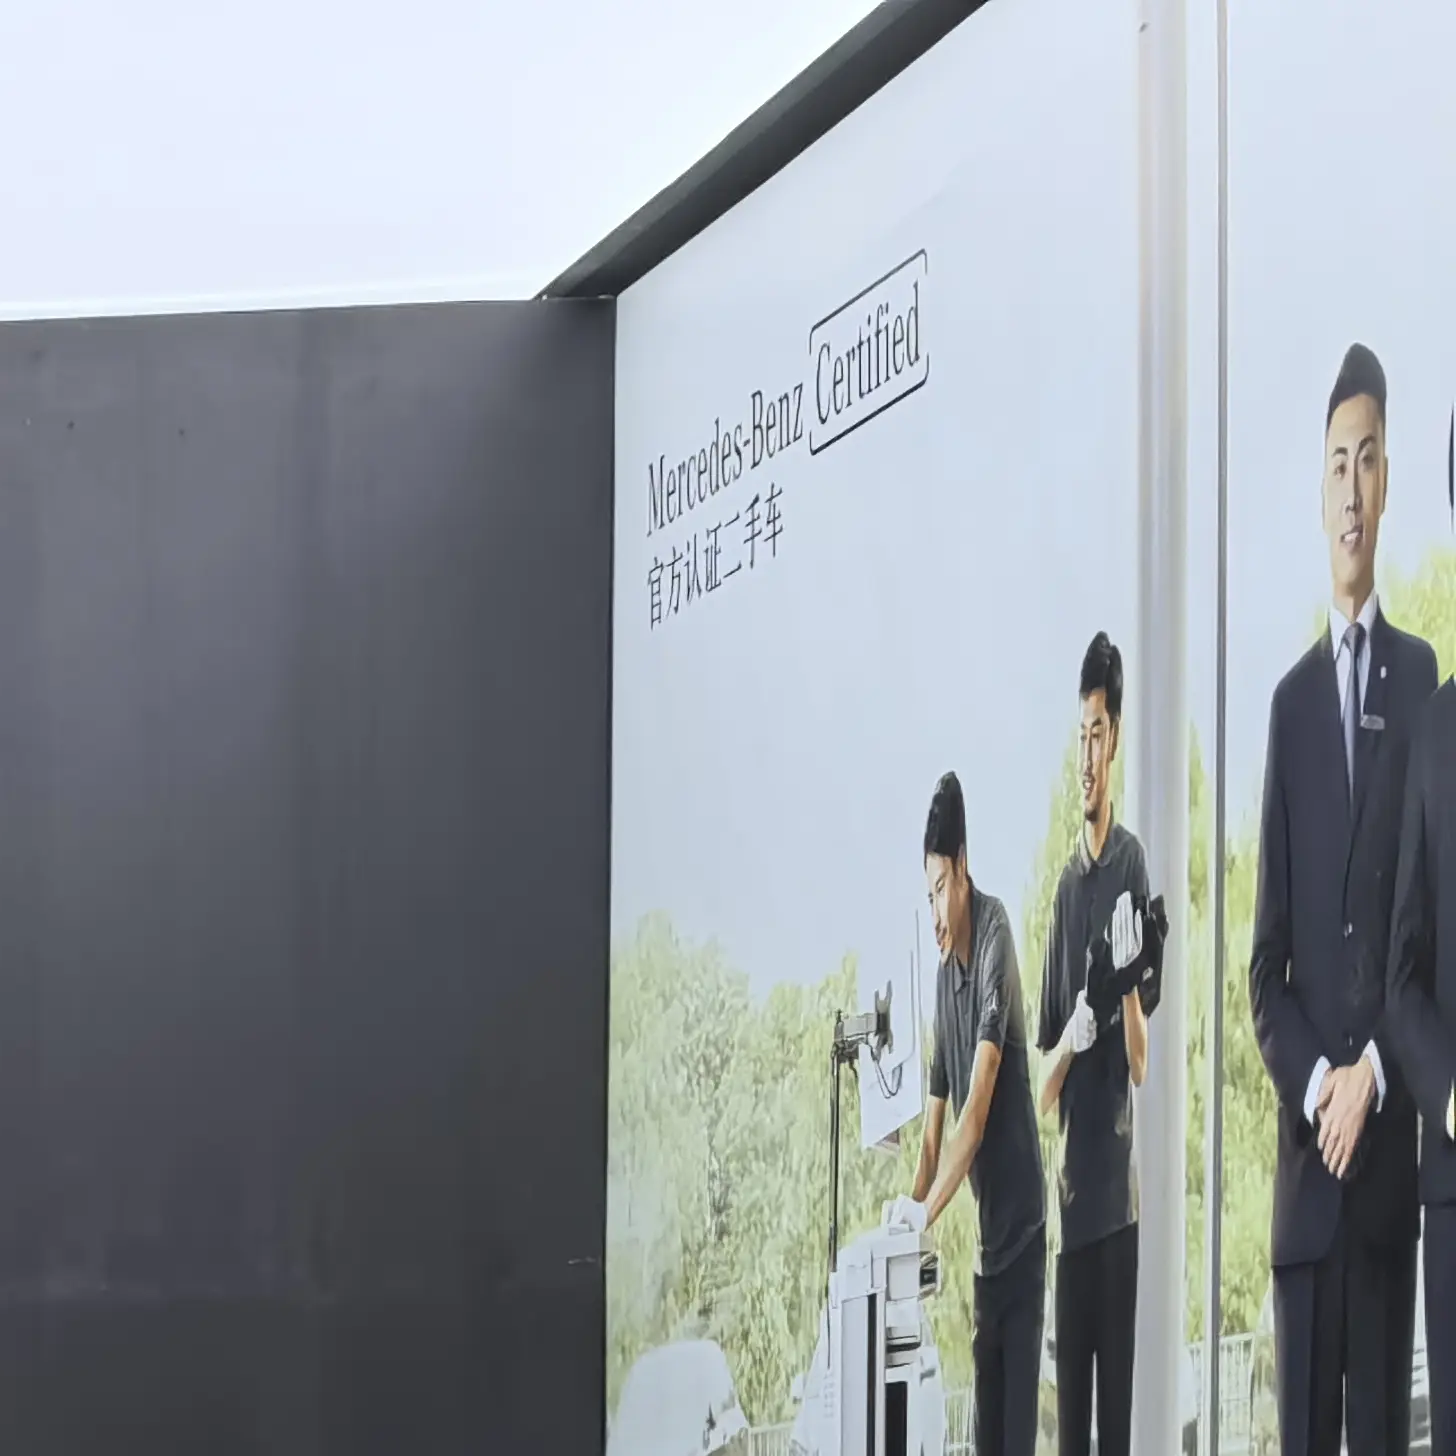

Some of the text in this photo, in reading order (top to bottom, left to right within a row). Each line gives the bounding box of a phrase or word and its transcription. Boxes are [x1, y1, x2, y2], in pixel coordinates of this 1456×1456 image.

[646, 280, 921, 538] Mercedes-Benz Certified
[647, 481, 783, 631] 官方认证二手车
